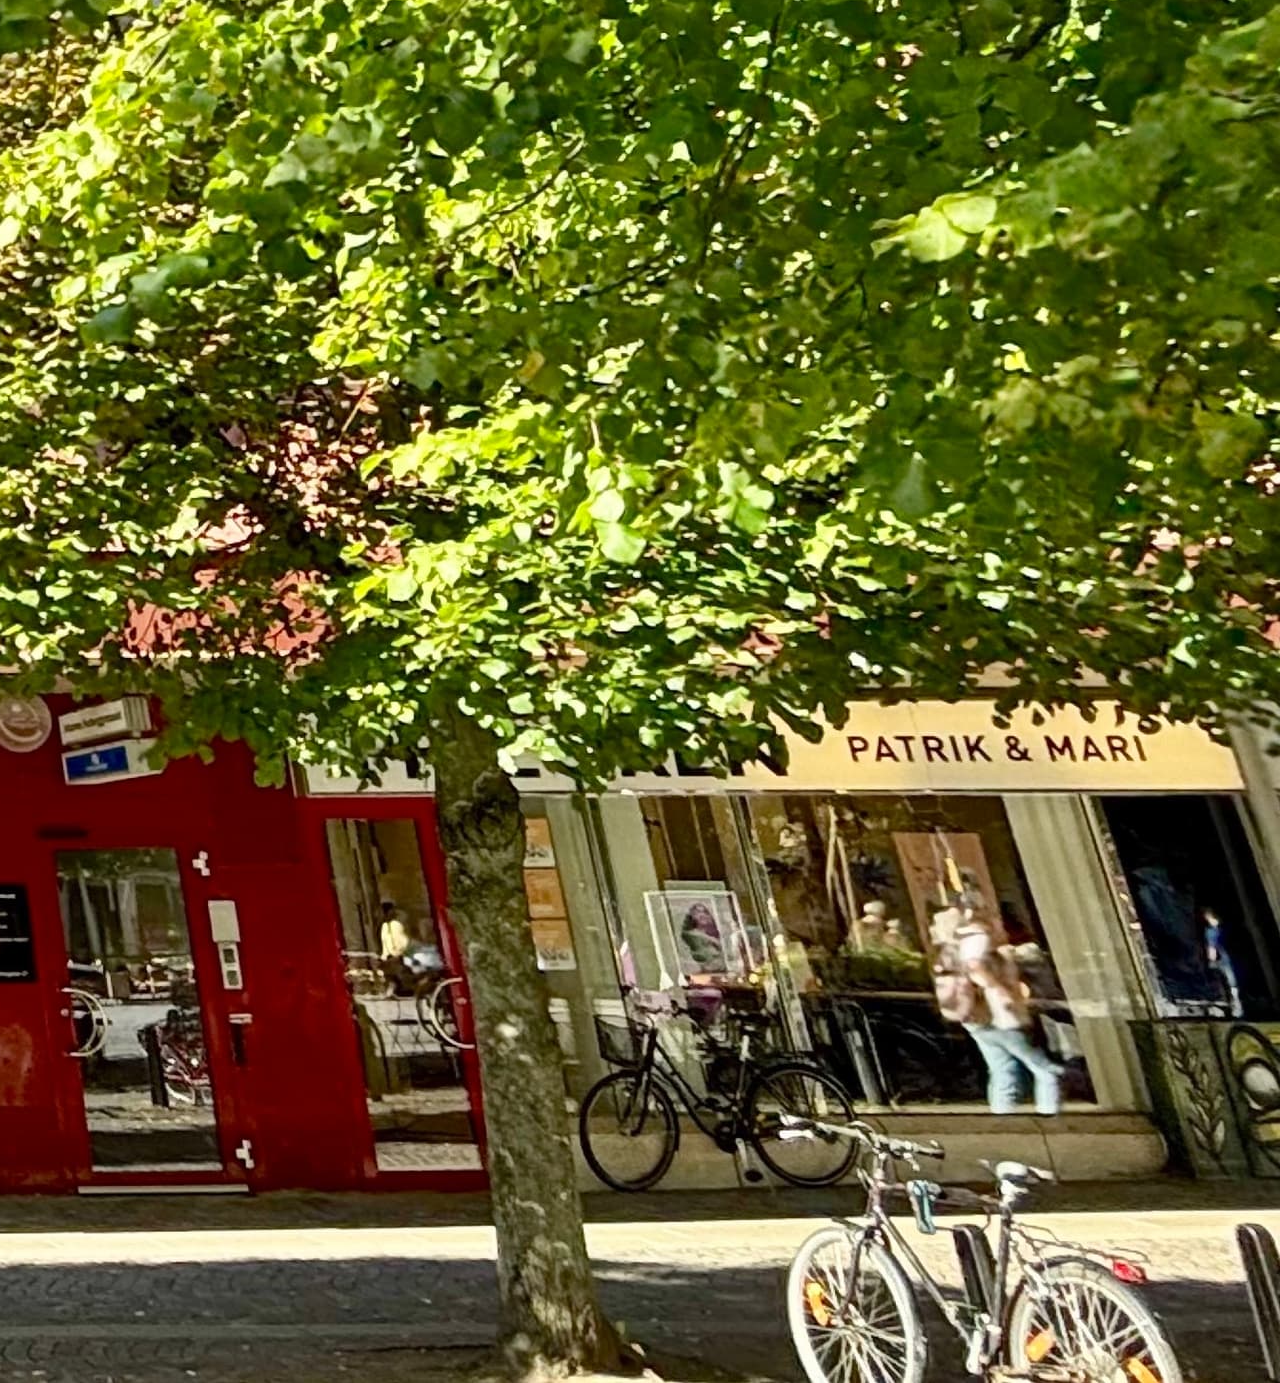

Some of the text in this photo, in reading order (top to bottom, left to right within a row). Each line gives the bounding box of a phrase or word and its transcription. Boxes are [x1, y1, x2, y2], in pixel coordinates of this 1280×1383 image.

[846, 735, 1148, 762] PATRIK & MARI
